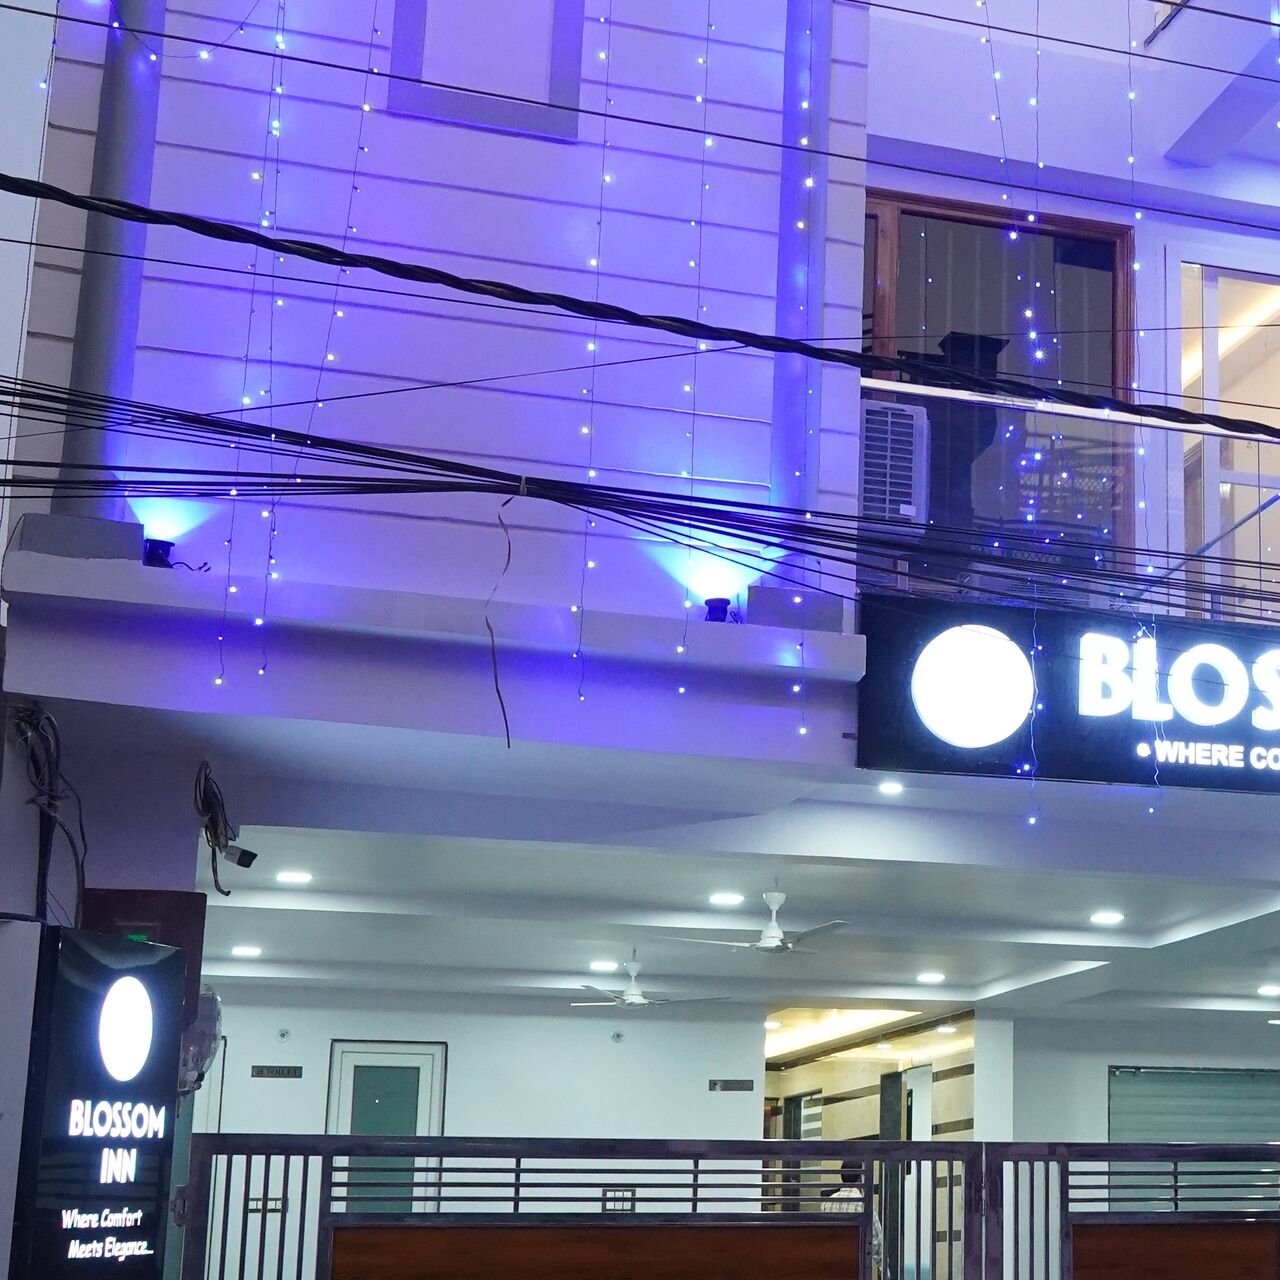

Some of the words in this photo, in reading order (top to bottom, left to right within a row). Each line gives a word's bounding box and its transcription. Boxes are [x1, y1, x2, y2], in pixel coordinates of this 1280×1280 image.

[1154, 740, 1245, 768] WHERE
[68, 1099, 166, 1138] BLOSSOM
[99, 1147, 137, 1184] INN
[61, 1208, 100, 1229] Where
[101, 1207, 143, 1228] Comfort
[67, 1239, 103, 1259] Meets
